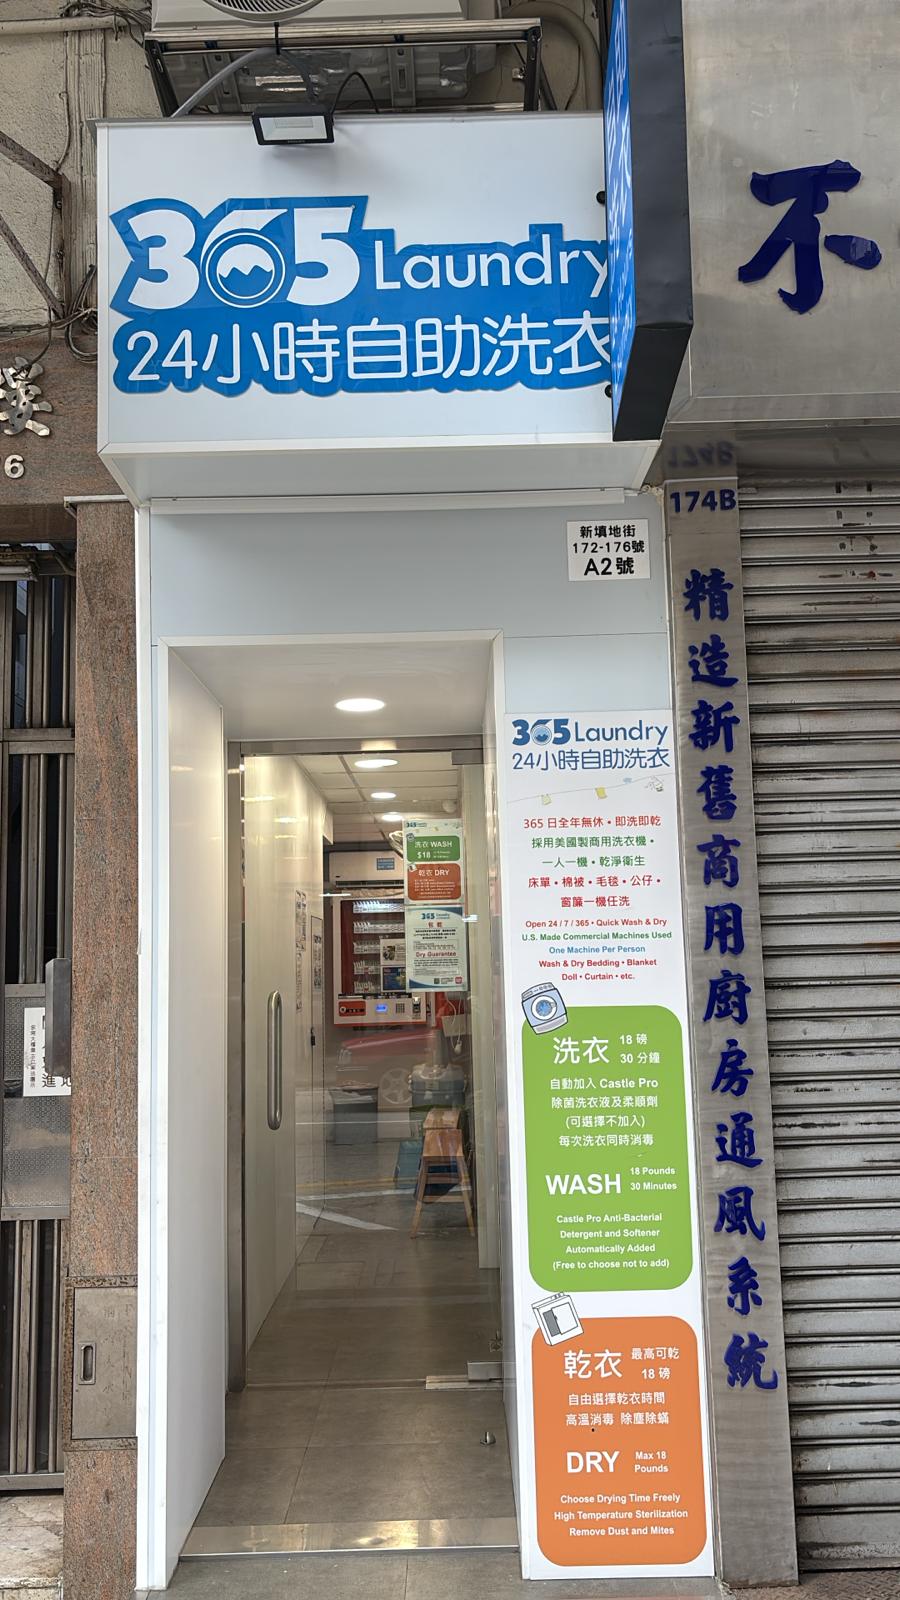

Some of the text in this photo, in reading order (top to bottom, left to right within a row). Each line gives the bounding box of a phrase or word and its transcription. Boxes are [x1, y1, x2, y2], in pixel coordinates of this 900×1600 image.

[738, 160, 882, 314] 不
[128, 206, 607, 310] 365 Laundry
[127, 310, 610, 384] 24小時自助洗衣
[4, 454, 25, 478] 6
[670, 489, 736, 513] 174B
[580, 525, 636, 538] 新填地街
[572, 540, 645, 553] 172-176號
[512, 718, 668, 746] 365 Laundry
[512, 747, 670, 770] 24小時自助洗衣
[524, 816, 662, 828] 365 日全年無休 即洗即乾
[532, 836, 646, 848] 採用美國製商用洗衣機
[542, 857, 588, 868] 一人一機
[528, 875, 652, 888] 床單 棉被 毛毯 公仔
[561, 896, 630, 908] 窗簾一機任洗
[526, 920, 546, 928] Open
[621, 918, 644, 926] Wash
[646, 918, 651, 926] &
[653, 918, 667, 927] Dry
[563, 932, 610, 940] Commercial
[652, 931, 672, 939] Used
[617, 945, 646, 953] Person
[571, 960, 584, 968] Dry
[586, 959, 620, 968] Bedding
[627, 958, 657, 966] Blanket
[561, 973, 578, 981] Doll
[584, 972, 614, 980] Curtain
[619, 1035, 633, 1044] 18
[553, 1036, 610, 1064] 洗衣
[620, 1054, 633, 1063] 30
[550, 1078, 658, 1089] 自動加入 Castle Pro
[551, 1096, 658, 1109] 除菌洗衣液及柔順劑
[559, 1134, 654, 1147] 每次洗衣同時消毒
[630, 1167, 675, 1175] 18 Pounds
[545, 1173, 622, 1195] WASH
[643, 1182, 677, 1190] Minutes
[556, 1213, 662, 1223] Castle Pro Anti-Bacterial
[560, 1229, 660, 1240] Detergent and Softener
[566, 1244, 655, 1254] Automatically Added
[553, 1261, 575, 1271] (Free
[577, 1261, 586, 1269] to
[588, 1260, 620, 1268] choose
[622, 1260, 637, 1268] not
[650, 1259, 670, 1269] add)
[631, 1347, 680, 1360] 最高可乾
[564, 1349, 623, 1379] 乾衣
[642, 1367, 671, 1379] 18 磅
[568, 1392, 665, 1406] 自由選擇乾衣時間
[635, 1451, 666, 1460] Max 18
[566, 1451, 620, 1473] DRY
[634, 1464, 668, 1473] Pounds
[560, 1493, 680, 1504] Choose Drying Time Freely
[554, 1509, 688, 1522] High Temperature Sterilization
[569, 1526, 674, 1536] Remove Dust and Mites
